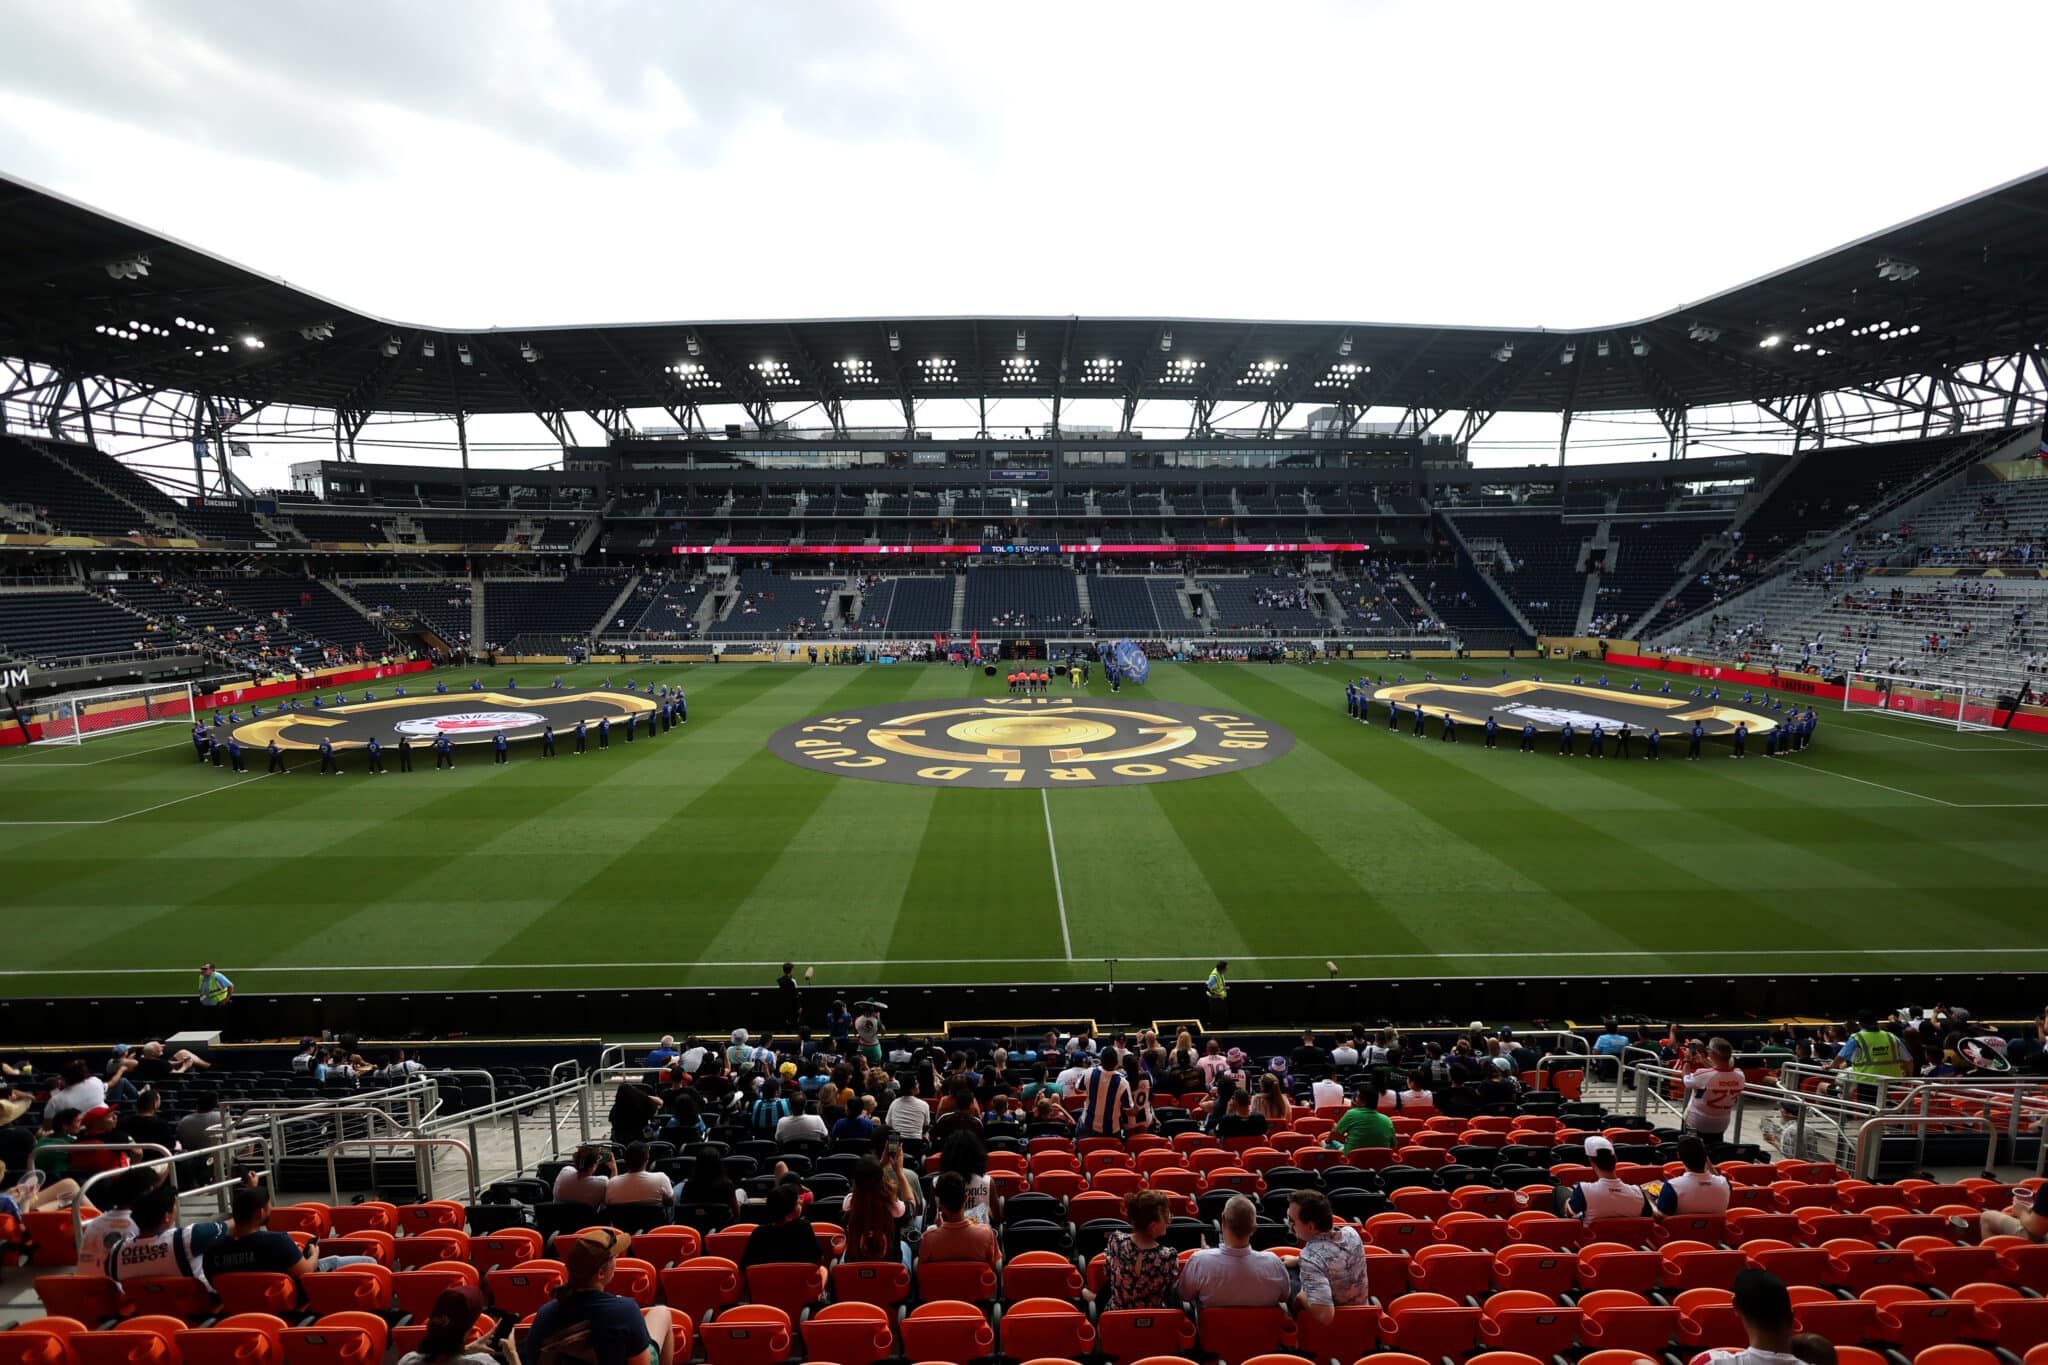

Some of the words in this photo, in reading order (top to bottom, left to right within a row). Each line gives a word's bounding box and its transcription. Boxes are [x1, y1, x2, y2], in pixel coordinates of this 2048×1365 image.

[802, 717, 863, 733] 25
[1198, 714, 1270, 749] CLUB
[794, 739, 887, 767] CUP
[917, 753, 1239, 781] WORLD
[121, 1241, 169, 1258] Office
[121, 1250, 168, 1265] DEPOT
